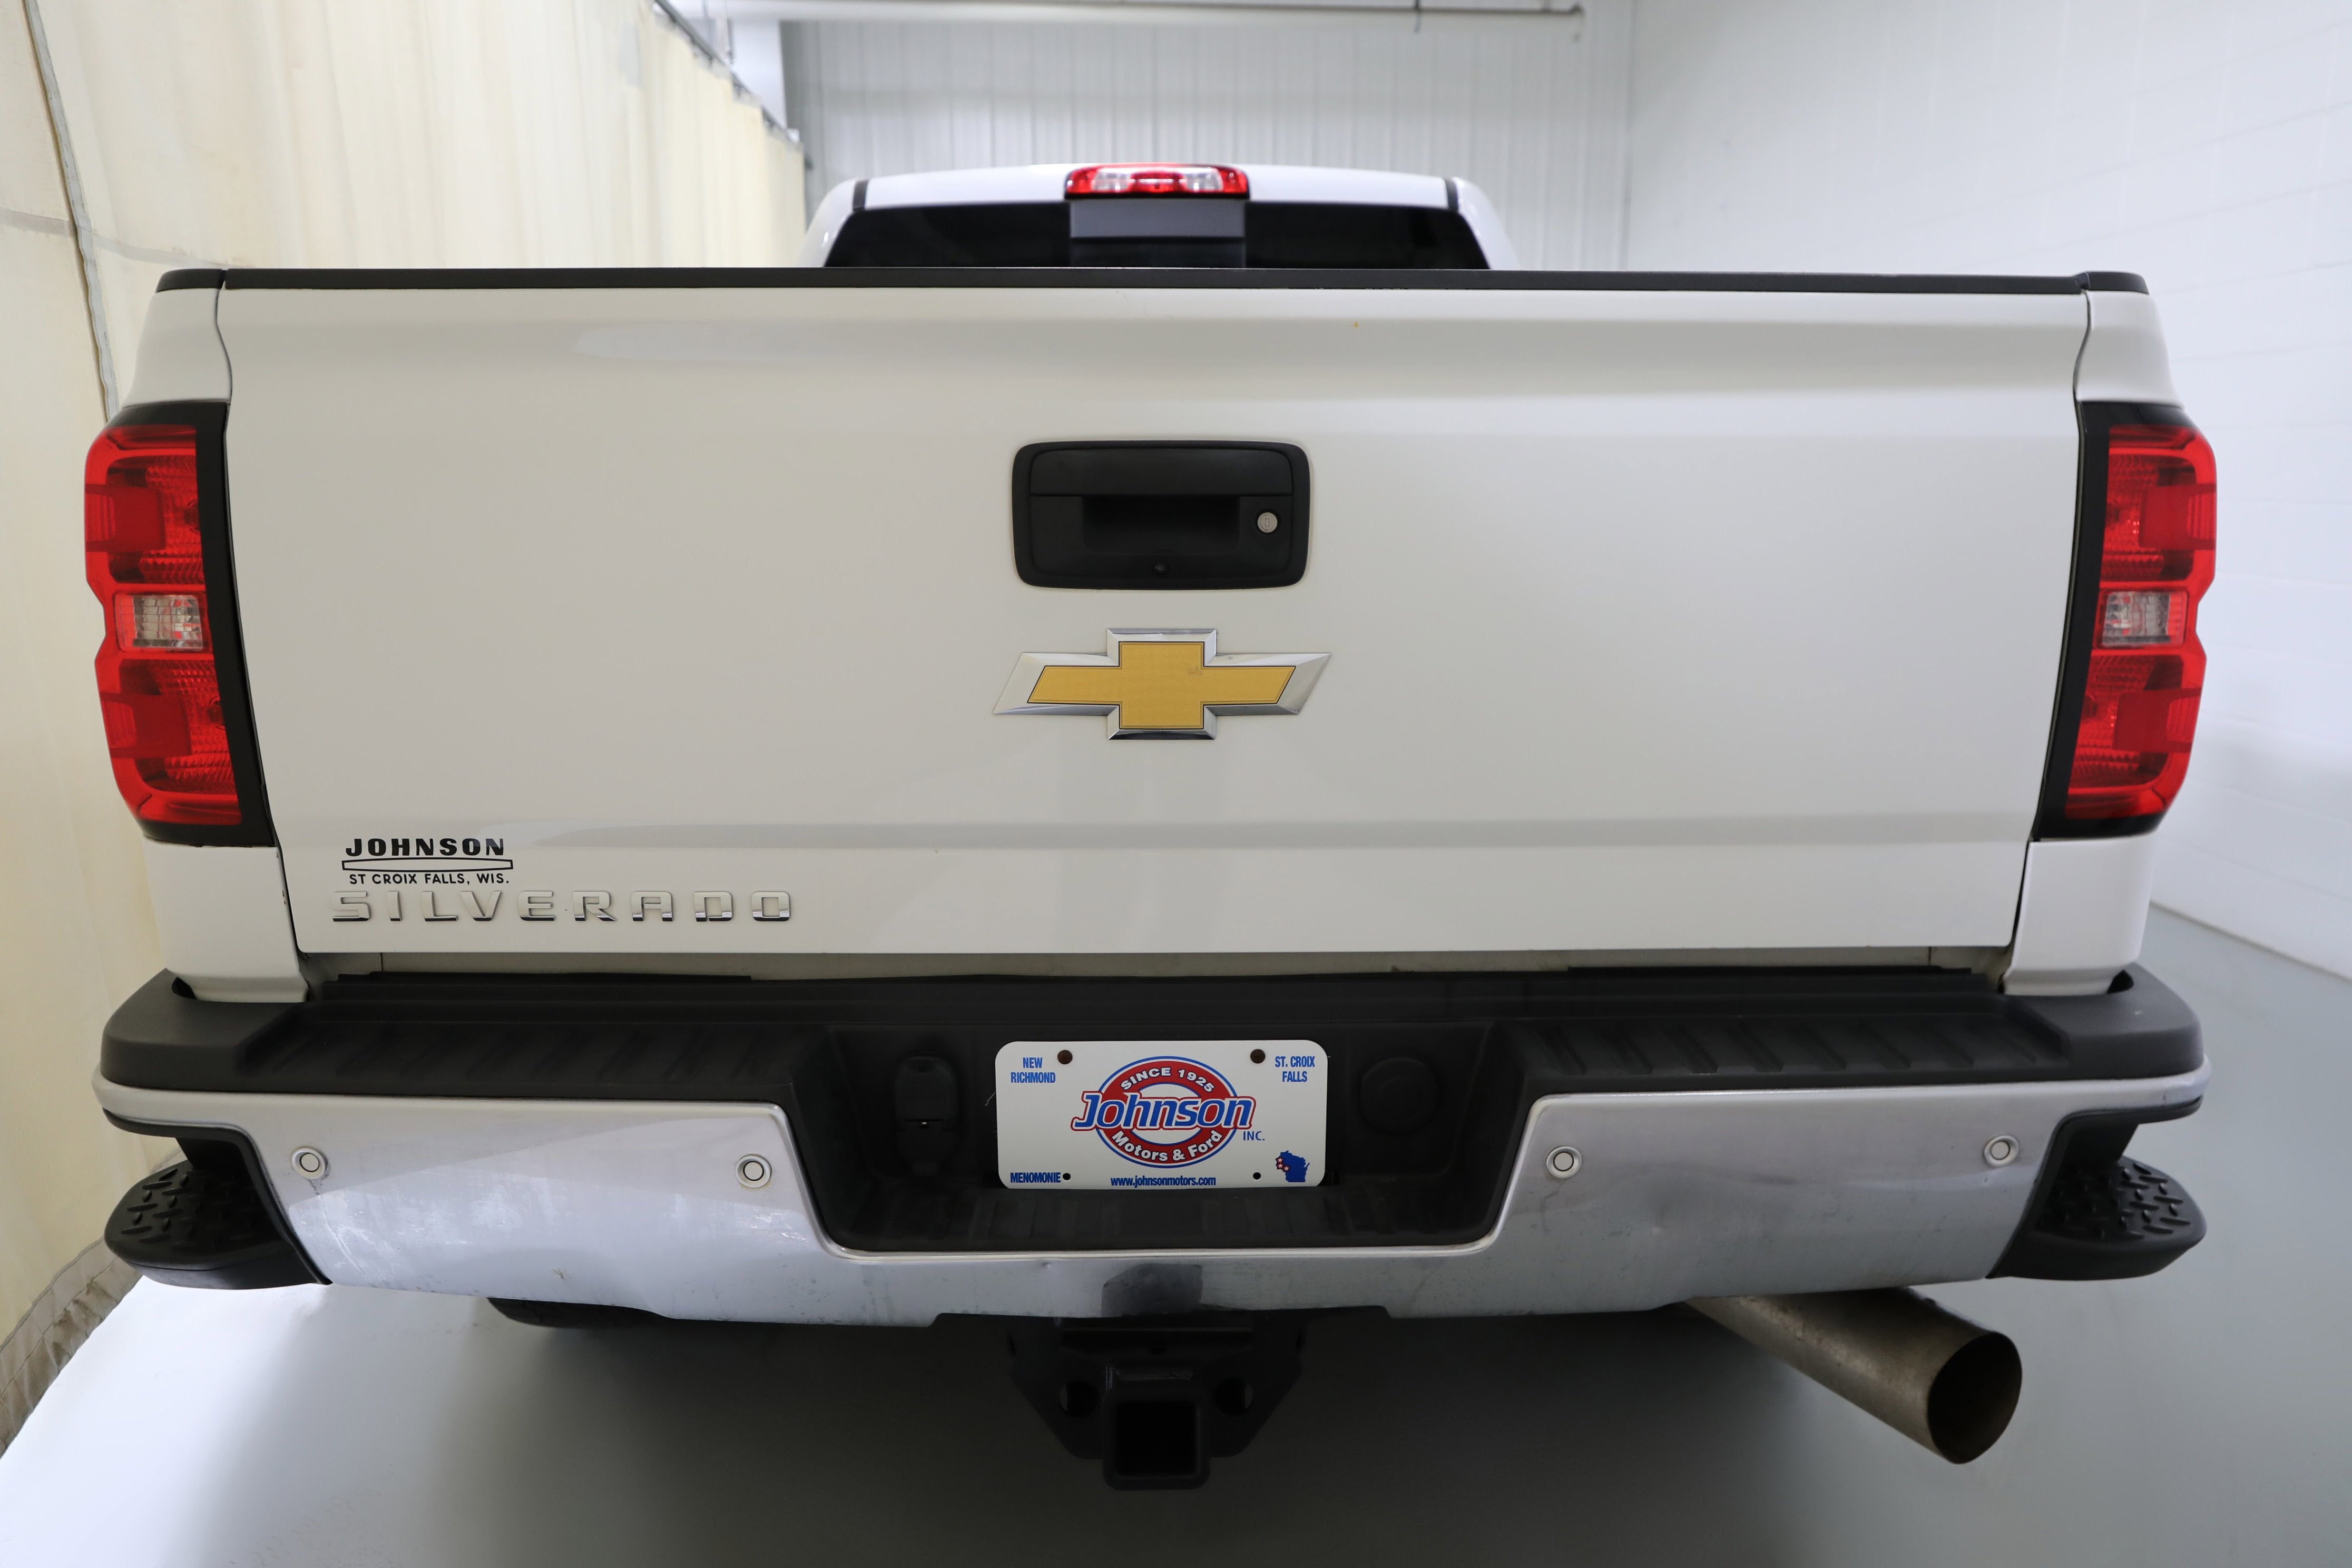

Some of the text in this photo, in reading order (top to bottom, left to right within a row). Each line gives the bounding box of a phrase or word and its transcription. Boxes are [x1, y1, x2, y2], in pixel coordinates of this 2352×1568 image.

[346, 838, 504, 857] JOHNSON
[349, 873, 509, 885] ST CROIX FALLS, WIS.
[332, 890, 791, 923] SILVERADO
[1022, 1057, 1043, 1069] NEW
[1275, 1055, 1316, 1069] ST. CROIX
[1011, 1072, 1056, 1084] RICHMOND
[1120, 1067, 1215, 1093] SINCE 1925
[1282, 1071, 1308, 1083] FALLS
[1073, 1093, 1253, 1129] Johnson
[1243, 1131, 1266, 1141] INC.
[1111, 1130, 1223, 1162] Motors & Ford
[1010, 1172, 1061, 1184] MENOMONIE
[1110, 1175, 1216, 1188] www.johnsonmotors.com
